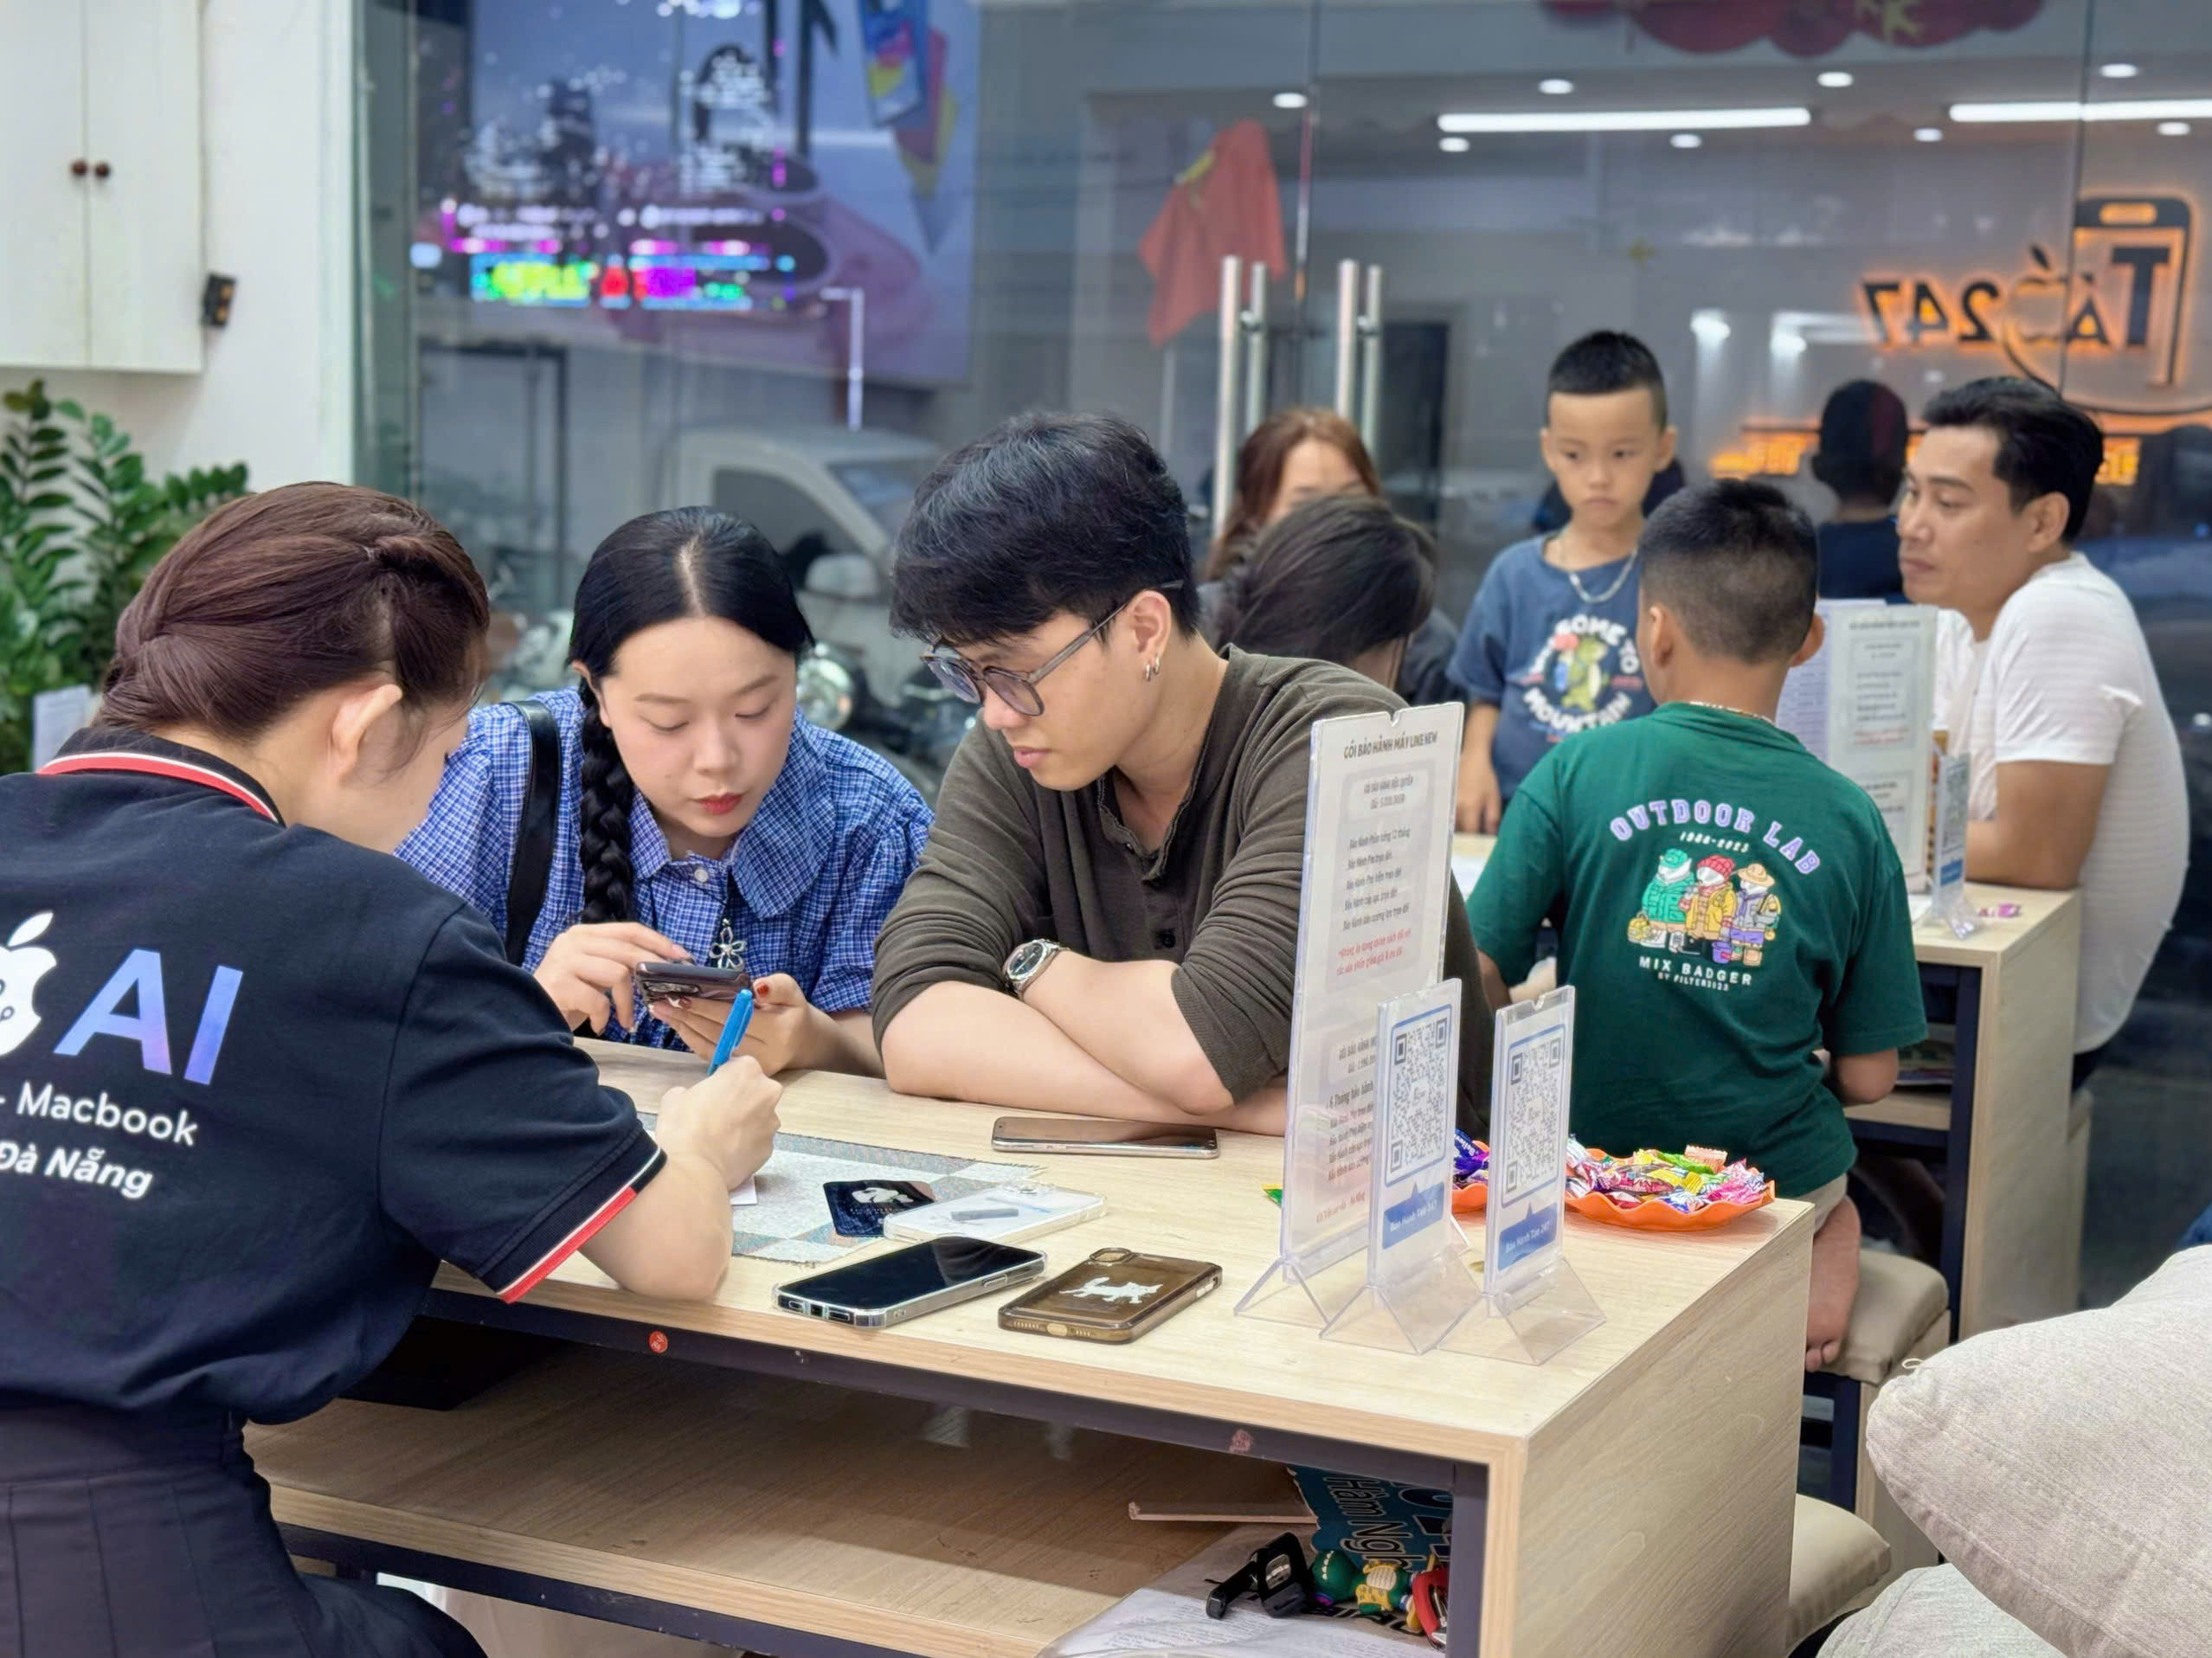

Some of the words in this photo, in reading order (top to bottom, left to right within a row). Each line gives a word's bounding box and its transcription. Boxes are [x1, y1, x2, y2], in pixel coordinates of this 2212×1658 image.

[1610, 799, 1756, 841] OUTDOOR
[1762, 820, 1821, 874] LAB
[1638, 955, 1671, 973] MIX
[1682, 962, 1752, 986] BADGER
[53, 948, 244, 1085] AI
[16, 1080, 199, 1147] Macbook
[44, 1147, 154, 1201] Nẵng
[1322, 1476, 1390, 1517] Hàm
